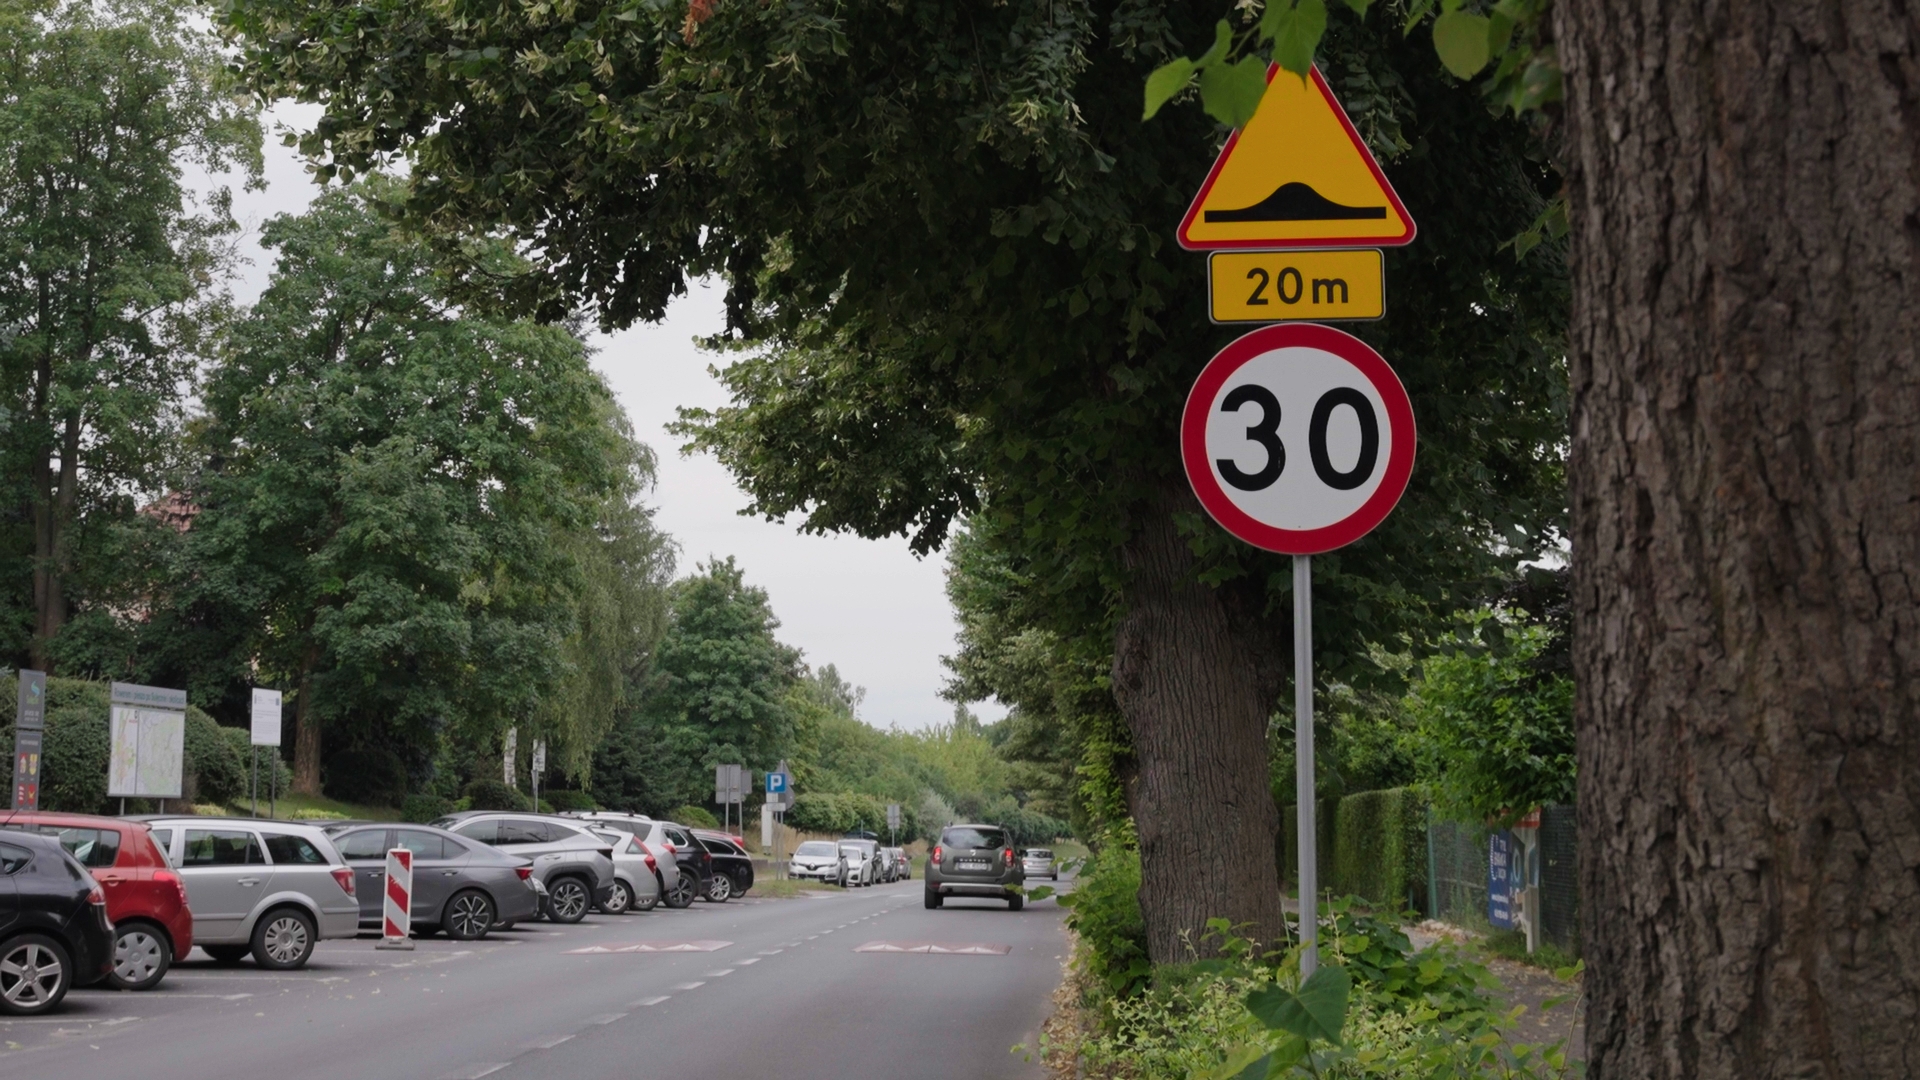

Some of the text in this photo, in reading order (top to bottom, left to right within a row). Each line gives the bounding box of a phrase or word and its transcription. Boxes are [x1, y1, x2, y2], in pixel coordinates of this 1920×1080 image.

[1245, 266, 1349, 307] 20m
[1215, 384, 1380, 492] 30
[770, 774, 783, 791] P
